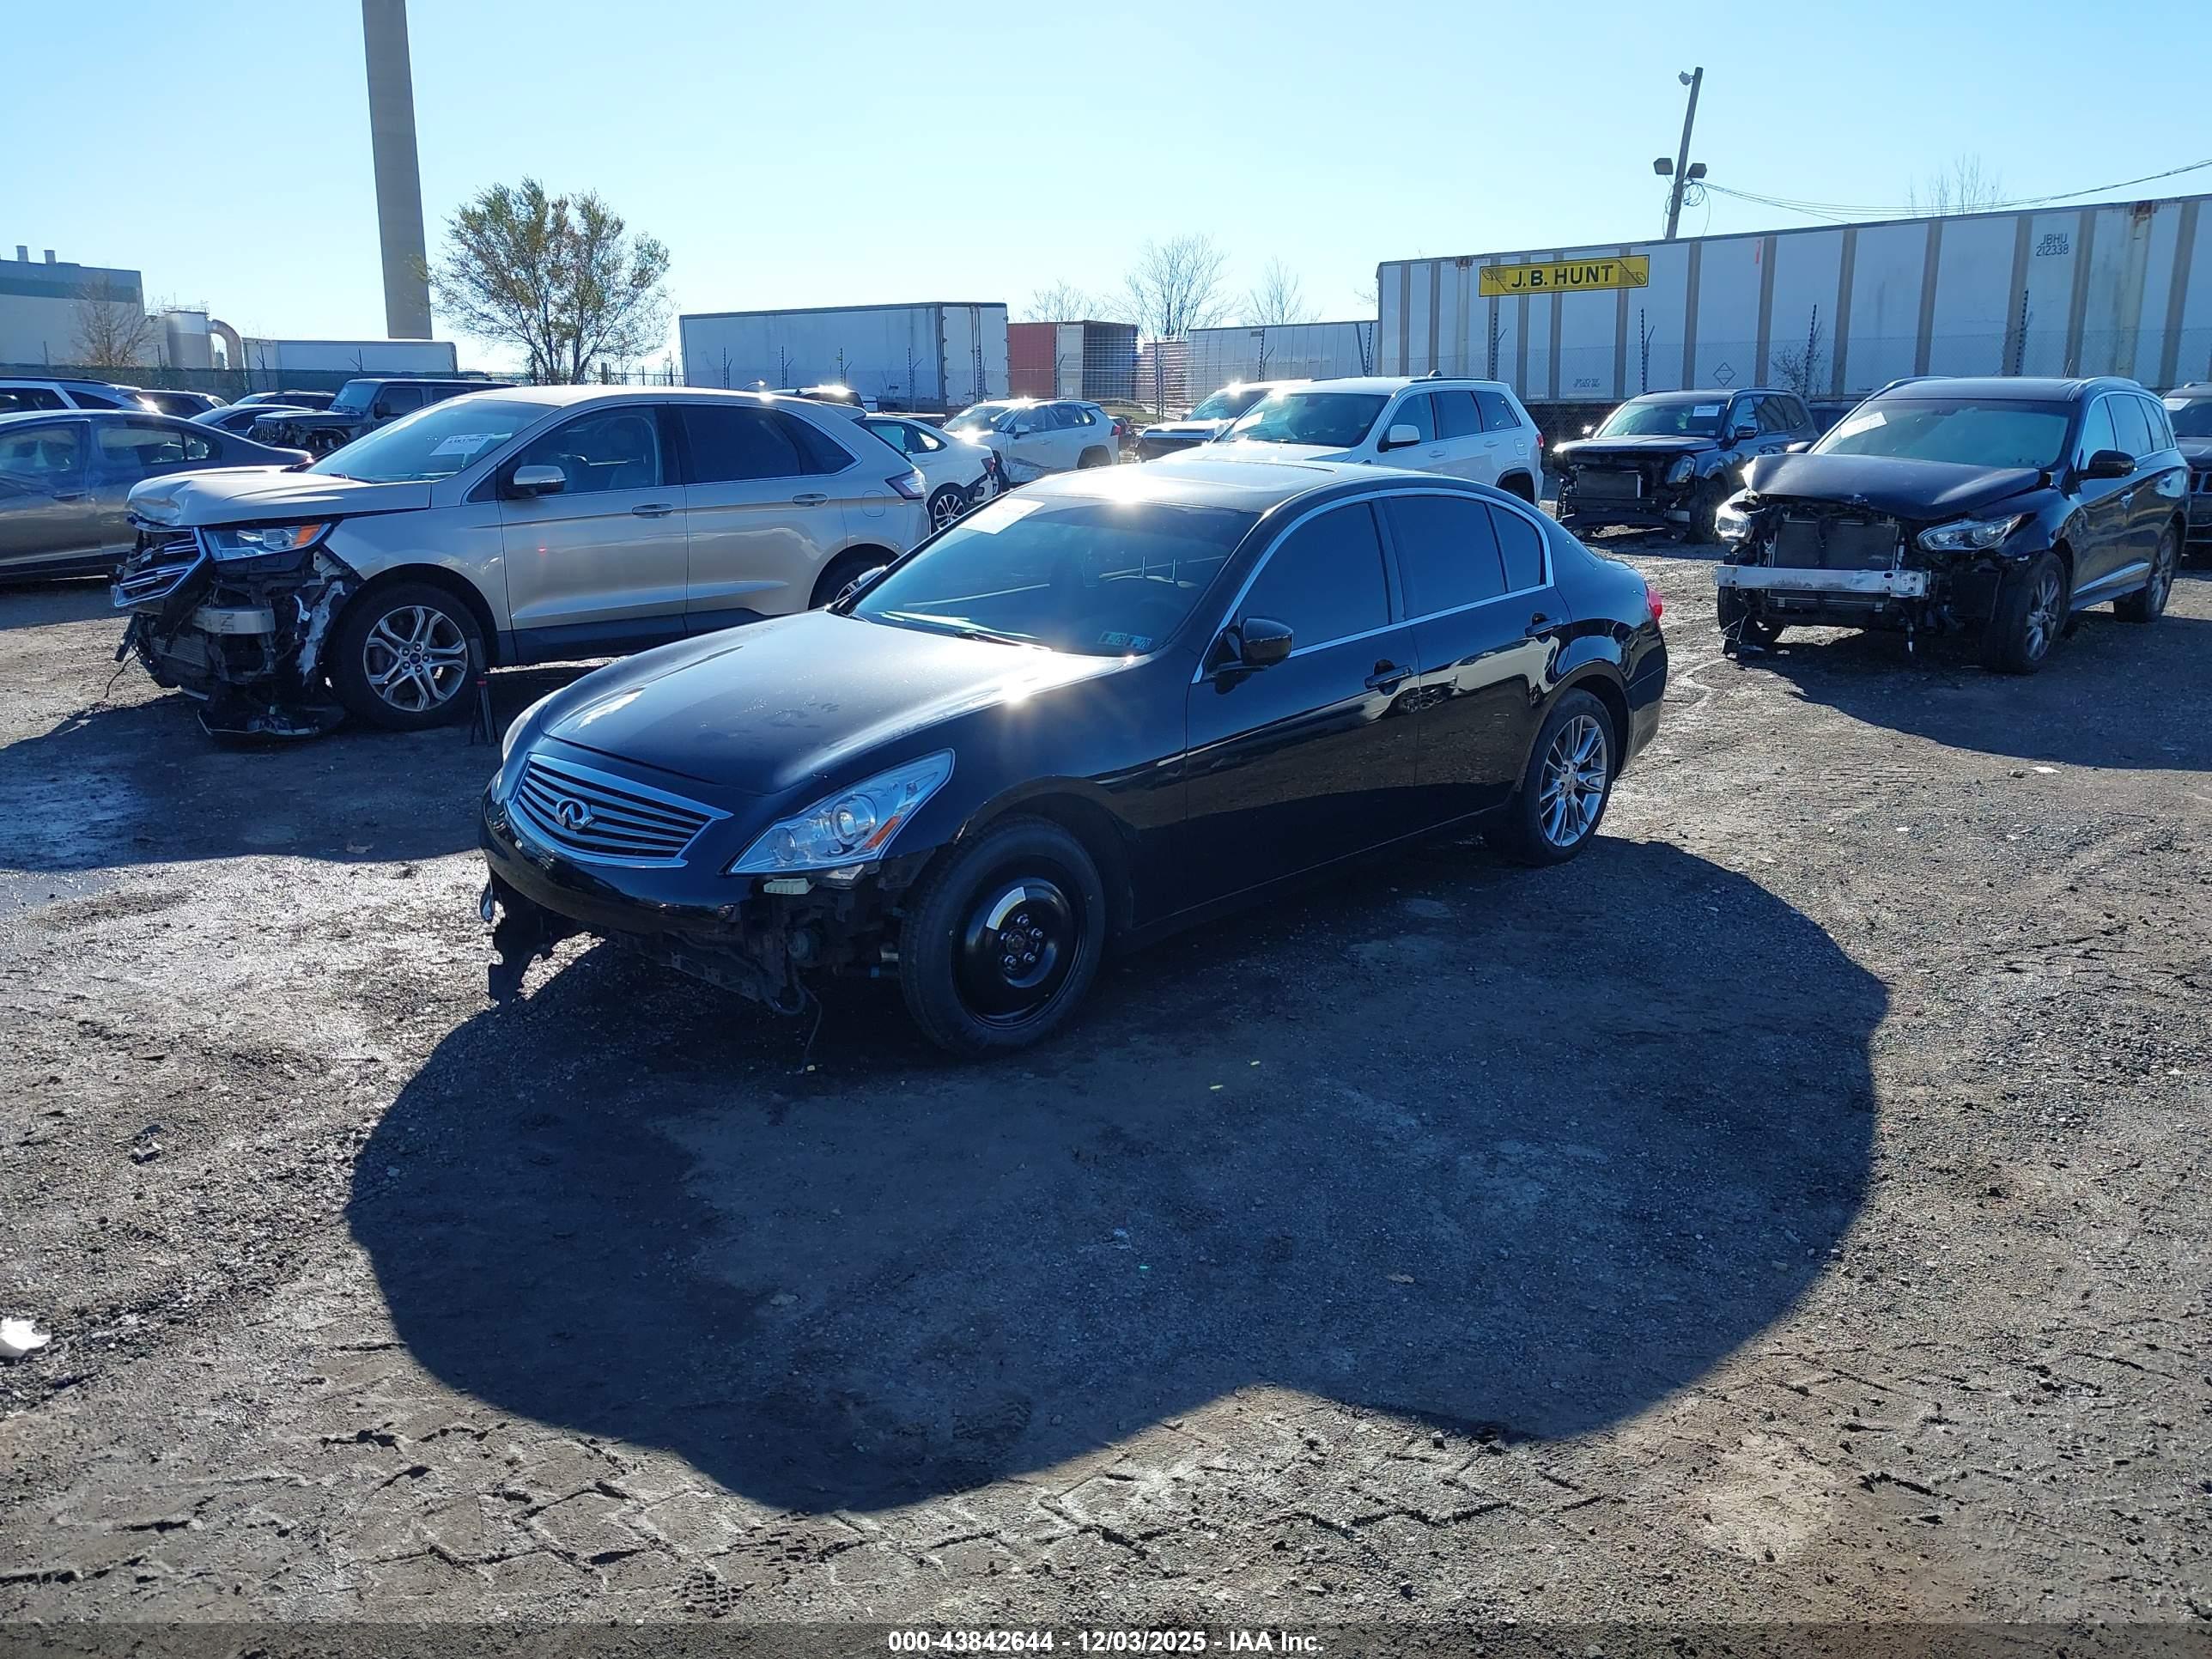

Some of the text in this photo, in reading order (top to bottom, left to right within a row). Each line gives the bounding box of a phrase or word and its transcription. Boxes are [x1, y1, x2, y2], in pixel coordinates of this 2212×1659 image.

[2041, 234, 2068, 246] JBHU
[2036, 244, 2069, 256] 212338
[1511, 264, 1613, 288] J.B. HUNT
